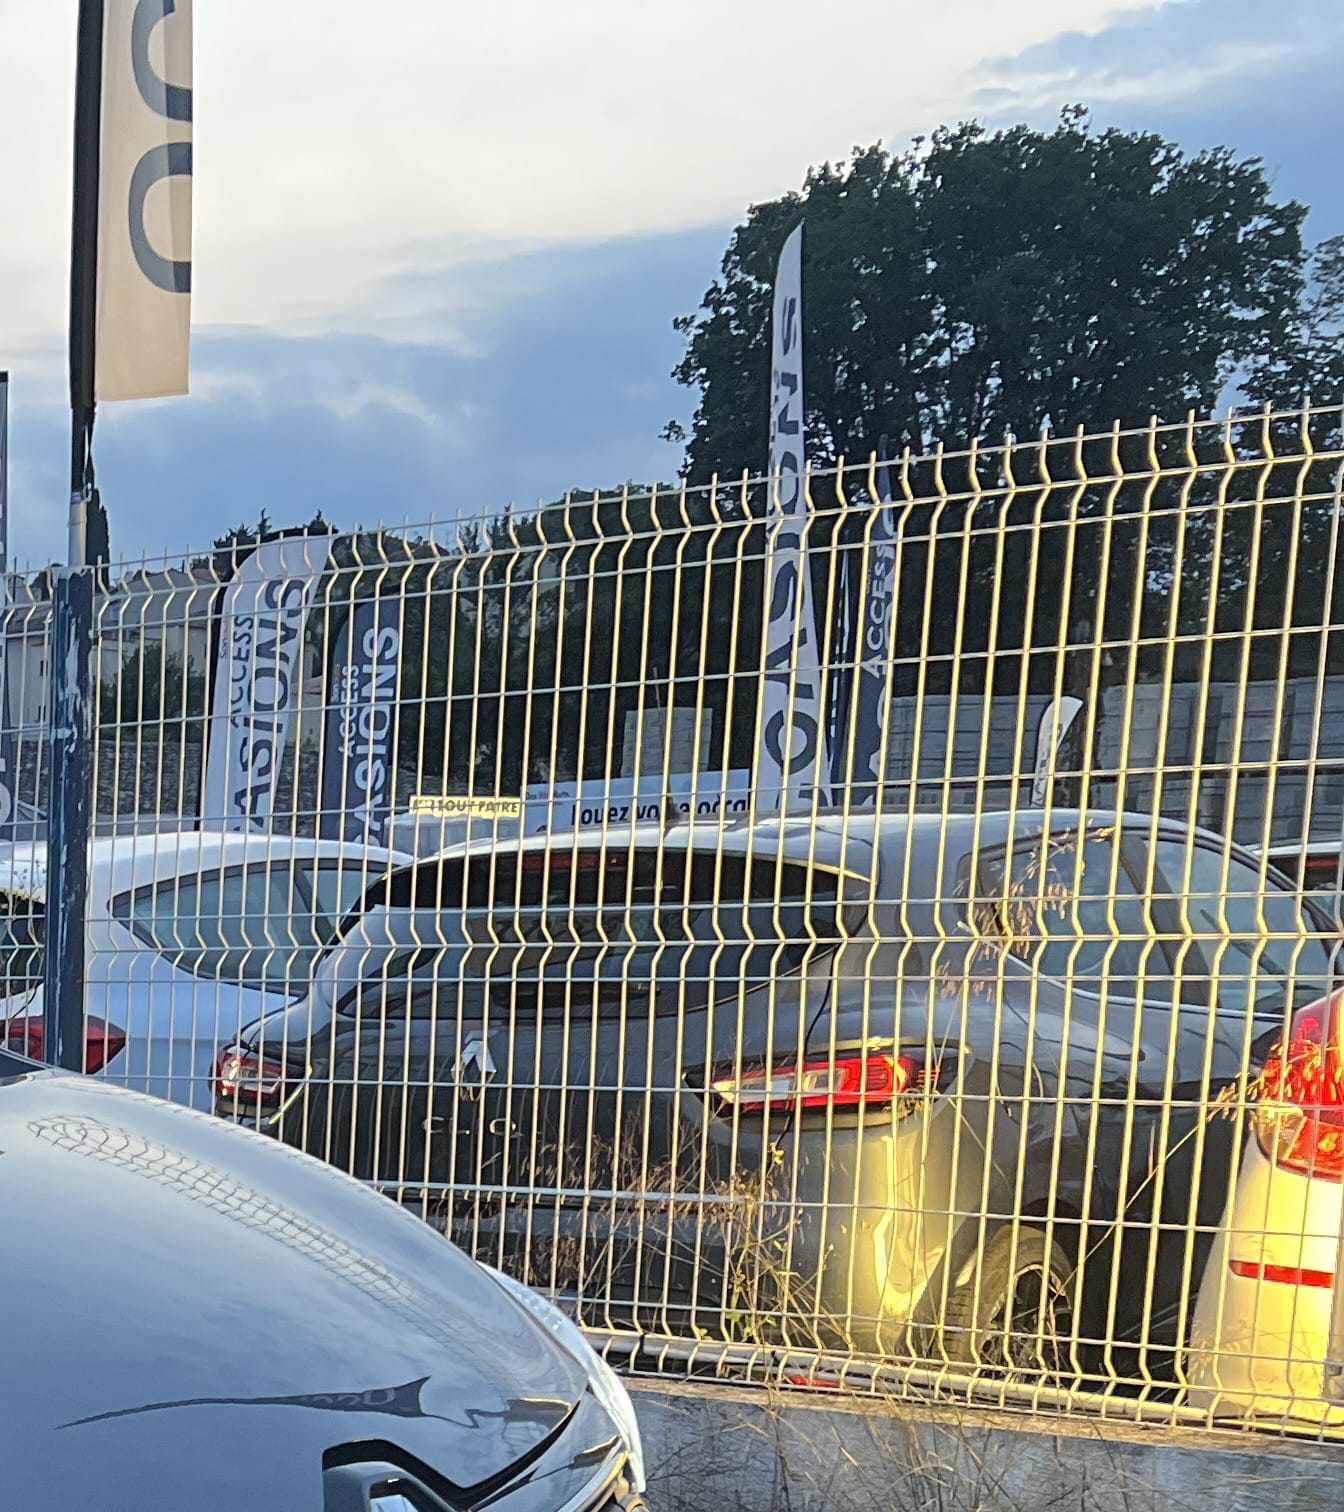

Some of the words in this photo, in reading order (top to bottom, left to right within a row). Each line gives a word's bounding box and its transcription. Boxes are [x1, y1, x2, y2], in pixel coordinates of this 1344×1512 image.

[764, 296, 819, 777] CASIONS
[229, 614, 255, 730] ACCESS
[338, 664, 360, 758] ACCESS
